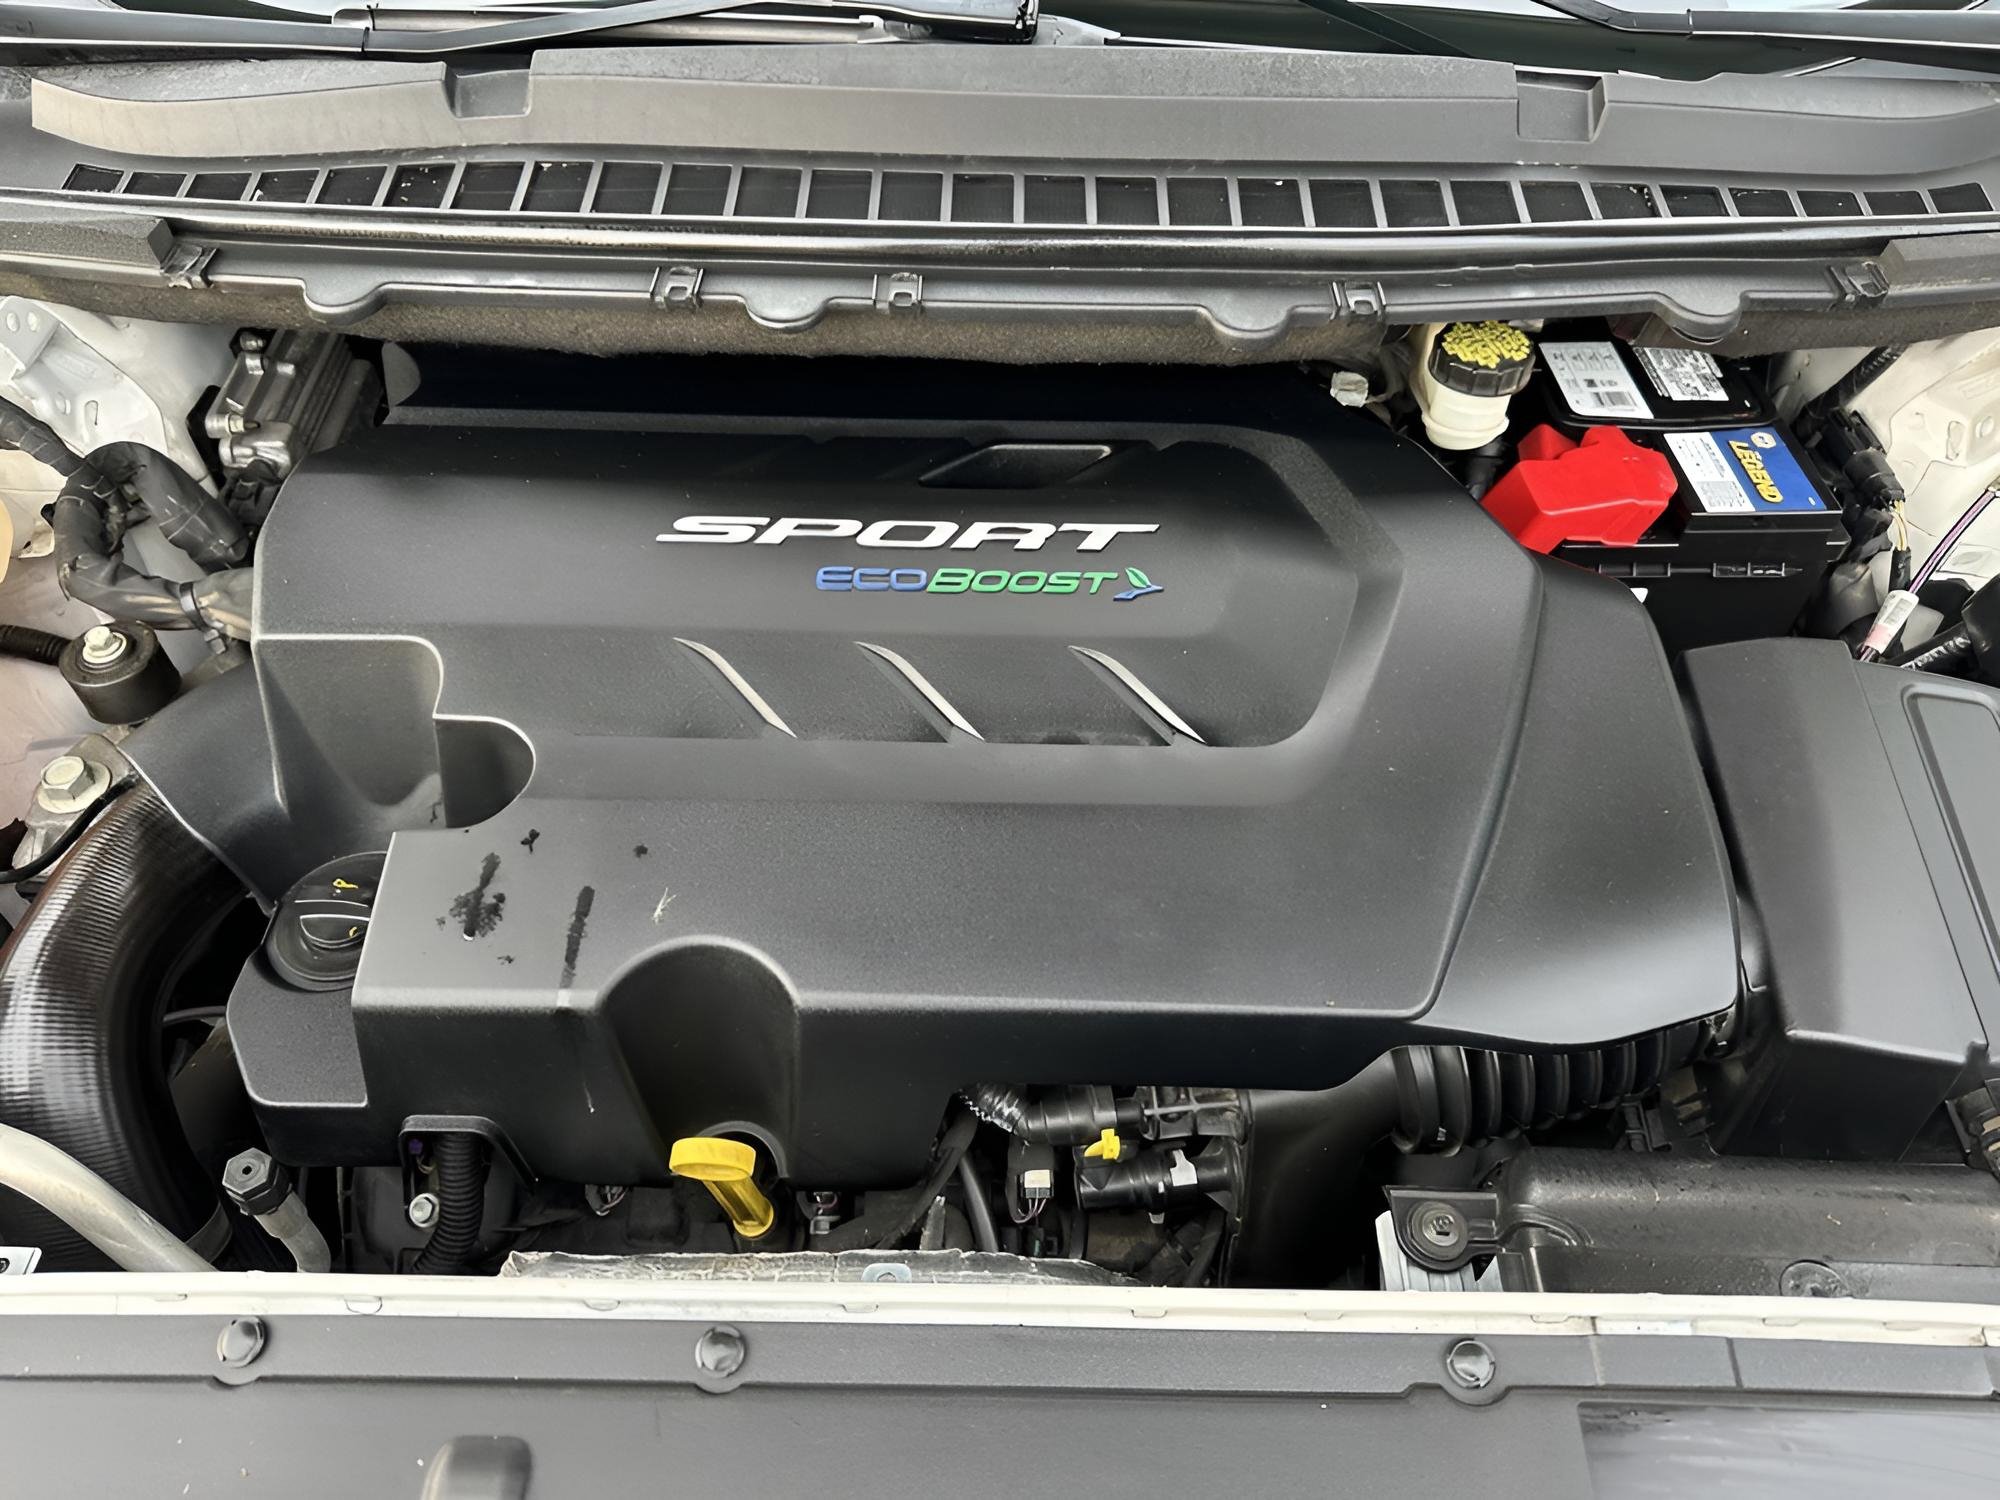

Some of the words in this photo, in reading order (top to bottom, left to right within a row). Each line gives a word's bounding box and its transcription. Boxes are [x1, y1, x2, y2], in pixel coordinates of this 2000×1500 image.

[1728, 440, 1784, 503] LEGEND
[656, 515, 1160, 551] SPORT
[816, 566, 1118, 595] ECOBOOST
